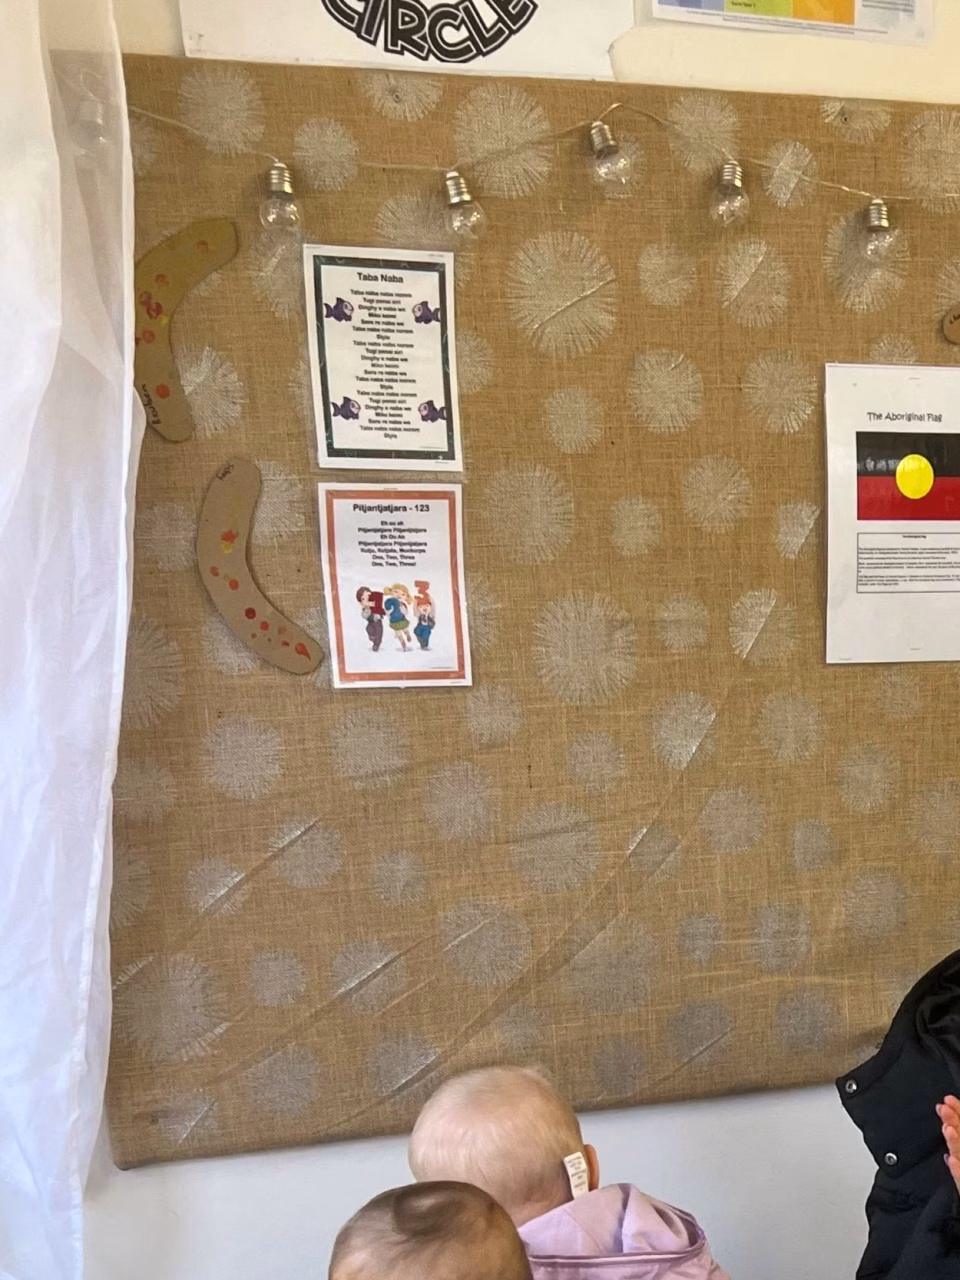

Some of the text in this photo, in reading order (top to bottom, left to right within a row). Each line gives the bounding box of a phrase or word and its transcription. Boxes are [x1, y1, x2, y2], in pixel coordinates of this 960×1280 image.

[357, 272, 404, 283] Taba Naba
[866, 412, 943, 423] The Aboriginal Flag
[353, 503, 407, 514] Pitjantjatjara
[414, 504, 430, 512] 123
